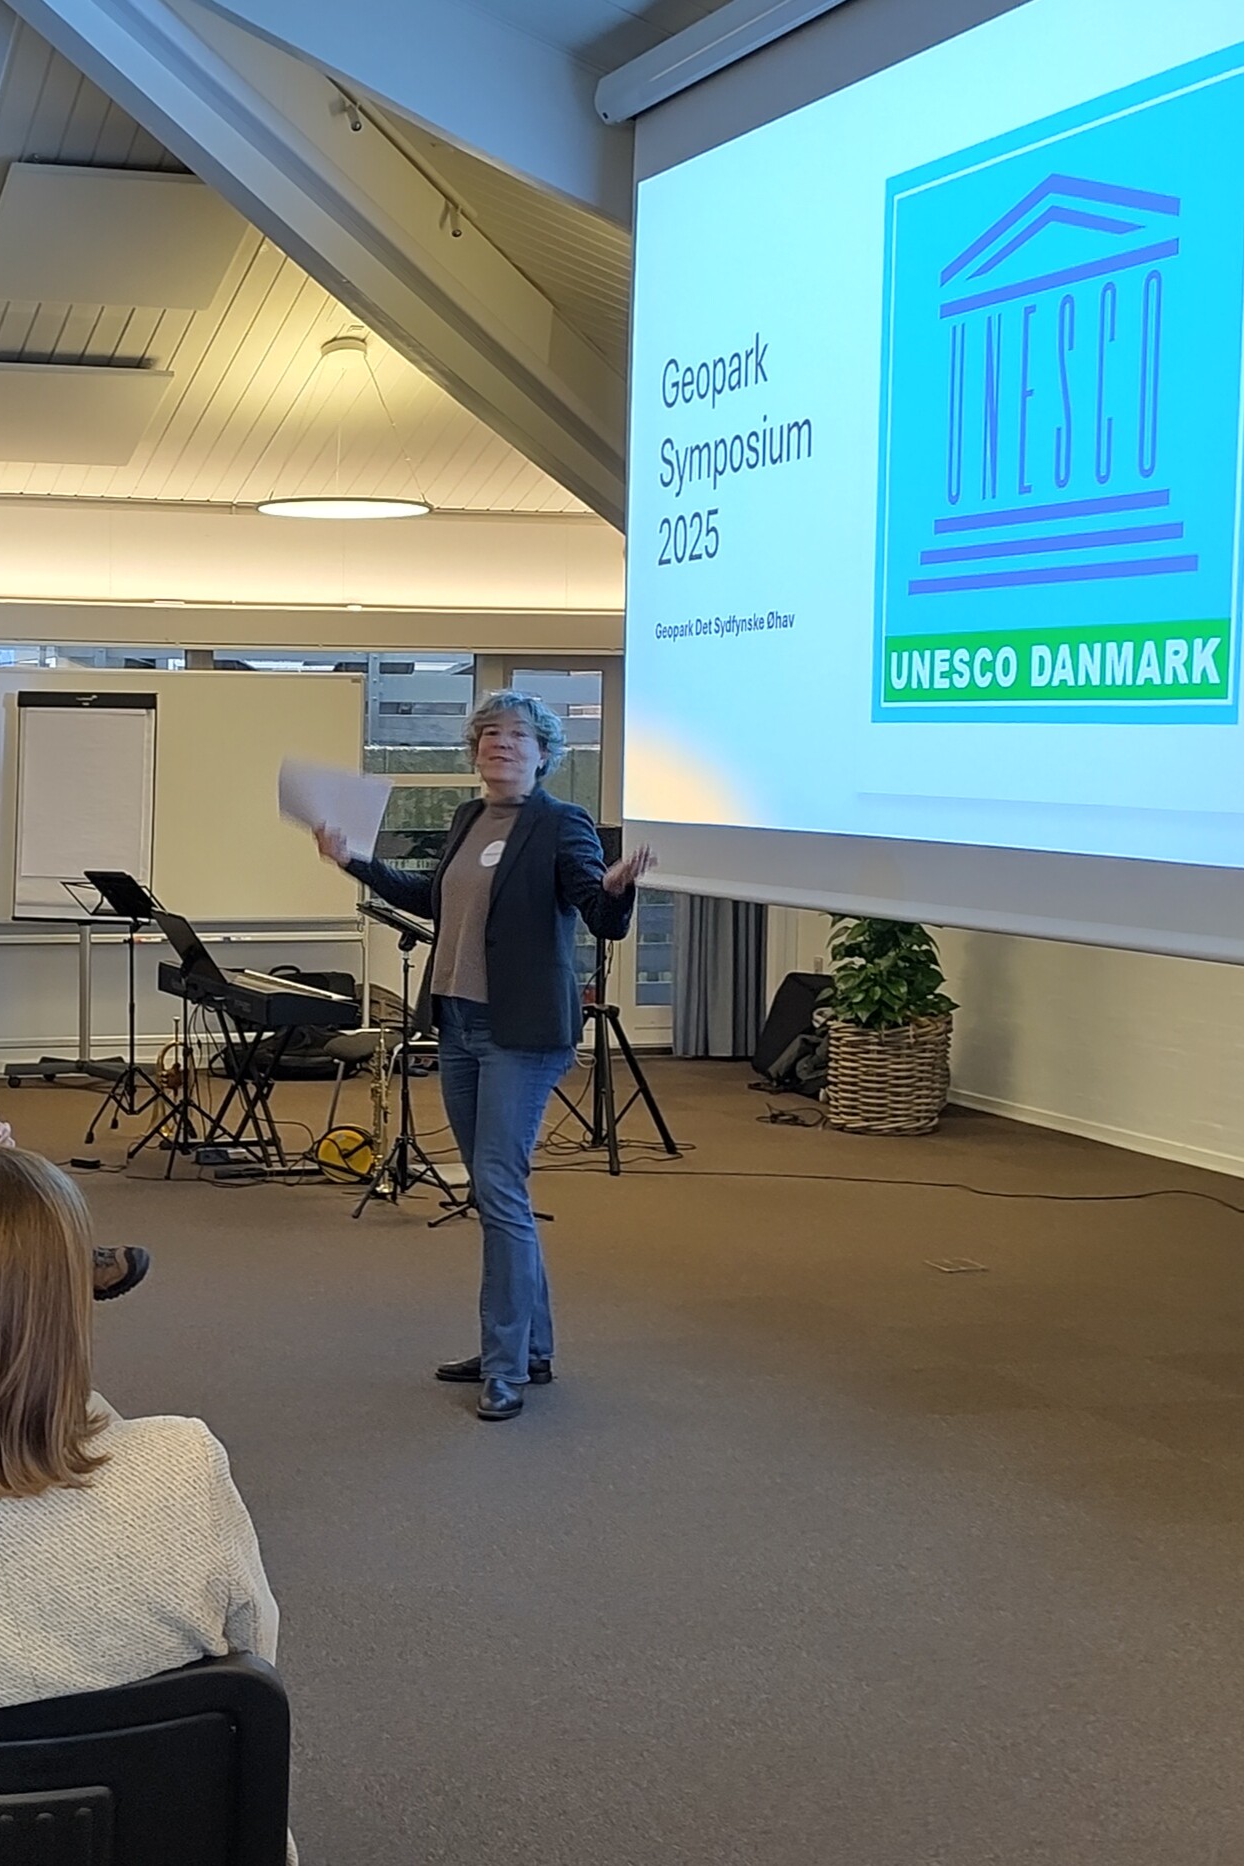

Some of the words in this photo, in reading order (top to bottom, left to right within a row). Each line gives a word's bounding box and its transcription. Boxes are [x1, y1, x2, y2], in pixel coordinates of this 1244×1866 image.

[662, 331, 769, 409] Geopark
[947, 269, 1163, 506] UNESCO
[659, 414, 813, 498] Symposium
[657, 508, 720, 566] 2025
[655, 619, 694, 643] Geopark
[695, 618, 713, 636] Det
[714, 613, 765, 638] Sydfynske
[766, 610, 796, 630] Øhav
[889, 645, 1018, 690] UNESCO
[1029, 636, 1222, 688] DANMARK
